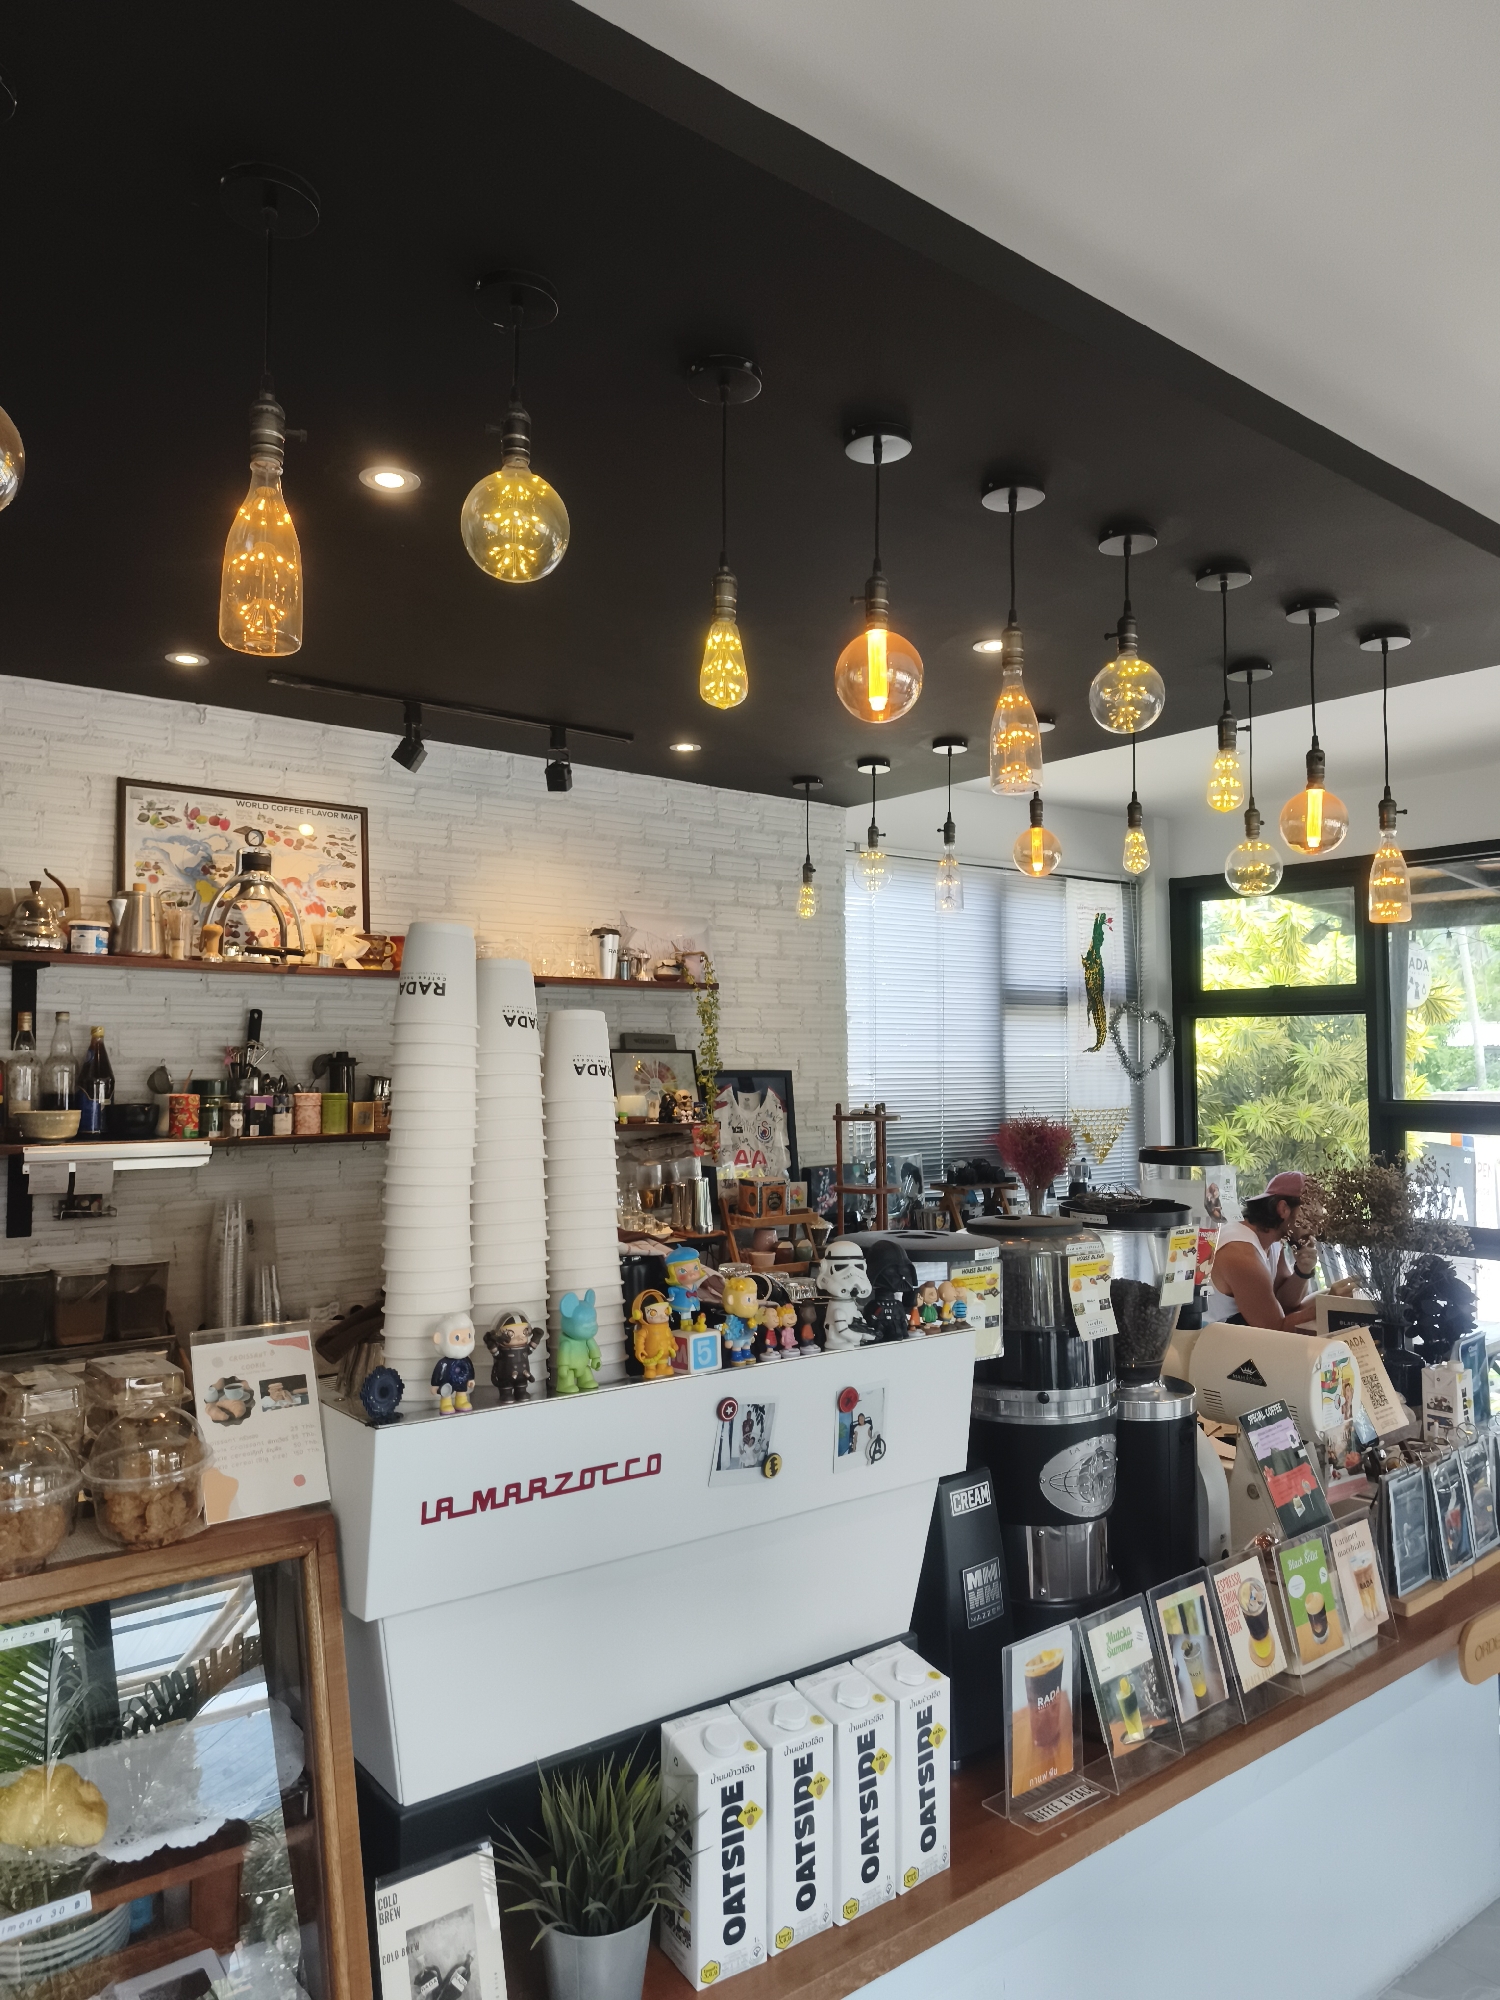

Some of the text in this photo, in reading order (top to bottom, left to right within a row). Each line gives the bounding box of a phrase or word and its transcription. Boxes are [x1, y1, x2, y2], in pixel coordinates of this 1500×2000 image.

[236, 799, 359, 821] WORLD COFFEE FLAVOR MAP
[1408, 957, 1430, 972] ADA
[229, 1351, 266, 1362] CROISSANT
[698, 1339, 712, 1366] 5
[241, 1362, 266, 1370] COOKIE
[420, 1452, 662, 1525] LA MARZOCCO
[952, 1485, 989, 1512] CREAM
[1216, 1572, 1242, 1594] ESPRESSO
[1220, 1590, 1239, 1607] LEMON
[970, 1605, 1002, 1624] MAZZER
[1224, 1604, 1241, 1621] HONEY
[1228, 1620, 1243, 1637] SODA
[1106, 1638, 1134, 1658] Summer
[1474, 1633, 1500, 1661] ORDE
[1037, 1685, 1060, 1706] RADA
[917, 1704, 937, 1853] OATSIDE
[1068, 1785, 1096, 1802] PEACH
[857, 1728, 880, 1884] OATSIDE
[793, 1752, 817, 1912] OATSIDE
[721, 1779, 747, 1946] OATSIDE
[50, 1906, 65, 1918] 30
[378, 1893, 398, 1911] COLD
[379, 1906, 401, 1926] BREW
[382, 1942, 420, 1966] COLD BREW
